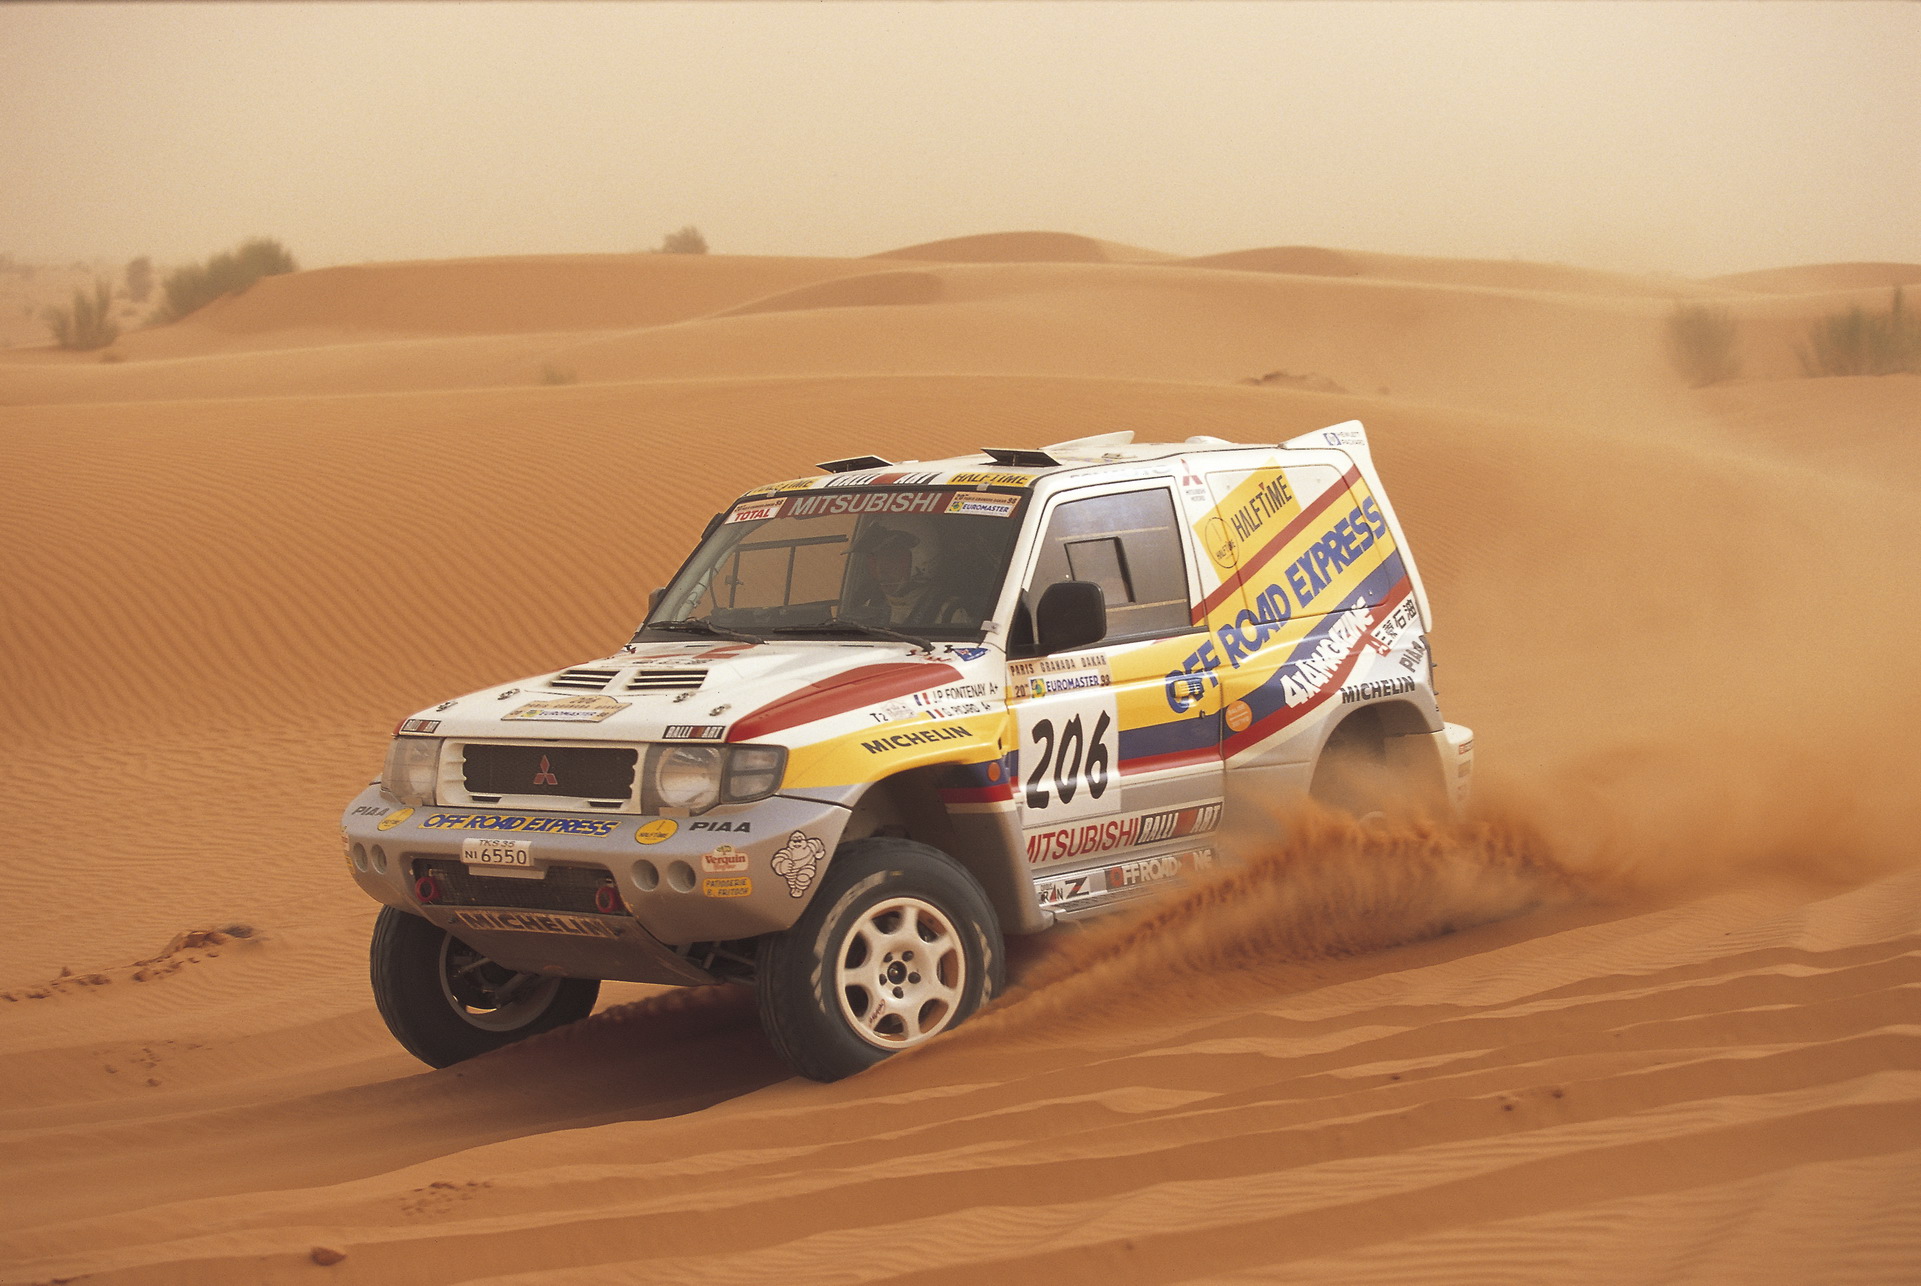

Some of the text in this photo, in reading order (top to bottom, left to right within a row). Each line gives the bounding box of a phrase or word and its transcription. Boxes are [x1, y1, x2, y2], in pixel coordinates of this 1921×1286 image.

[787, 492, 943, 516] MITSUBISHI
[962, 503, 1010, 513] EUROMASTER
[1230, 474, 1292, 543] HALFTIME
[734, 508, 771, 522] TOTAL
[1165, 496, 1387, 714] OFF ROAD EXPRESS
[1010, 655, 1107, 677] PARIS GRANADA DAKAR
[945, 683, 987, 700] FONTENAY
[1045, 675, 1100, 692] EUROMASTER
[1339, 675, 1416, 704] MICHELIN
[869, 712, 889, 723] T2
[860, 726, 974, 754] MICHELIN
[1026, 709, 1111, 809] 206
[351, 806, 390, 817] PIAA
[423, 814, 619, 837] OFF ROAD EXPRESS
[688, 821, 751, 833] PIAA
[1027, 804, 1222, 864] MITSUBISHI RALLI ART
[479, 839, 516, 848] TKS 35
[481, 848, 528, 865] 6550
[705, 854, 746, 866] Verquin
[460, 911, 614, 936] MICHELIN
